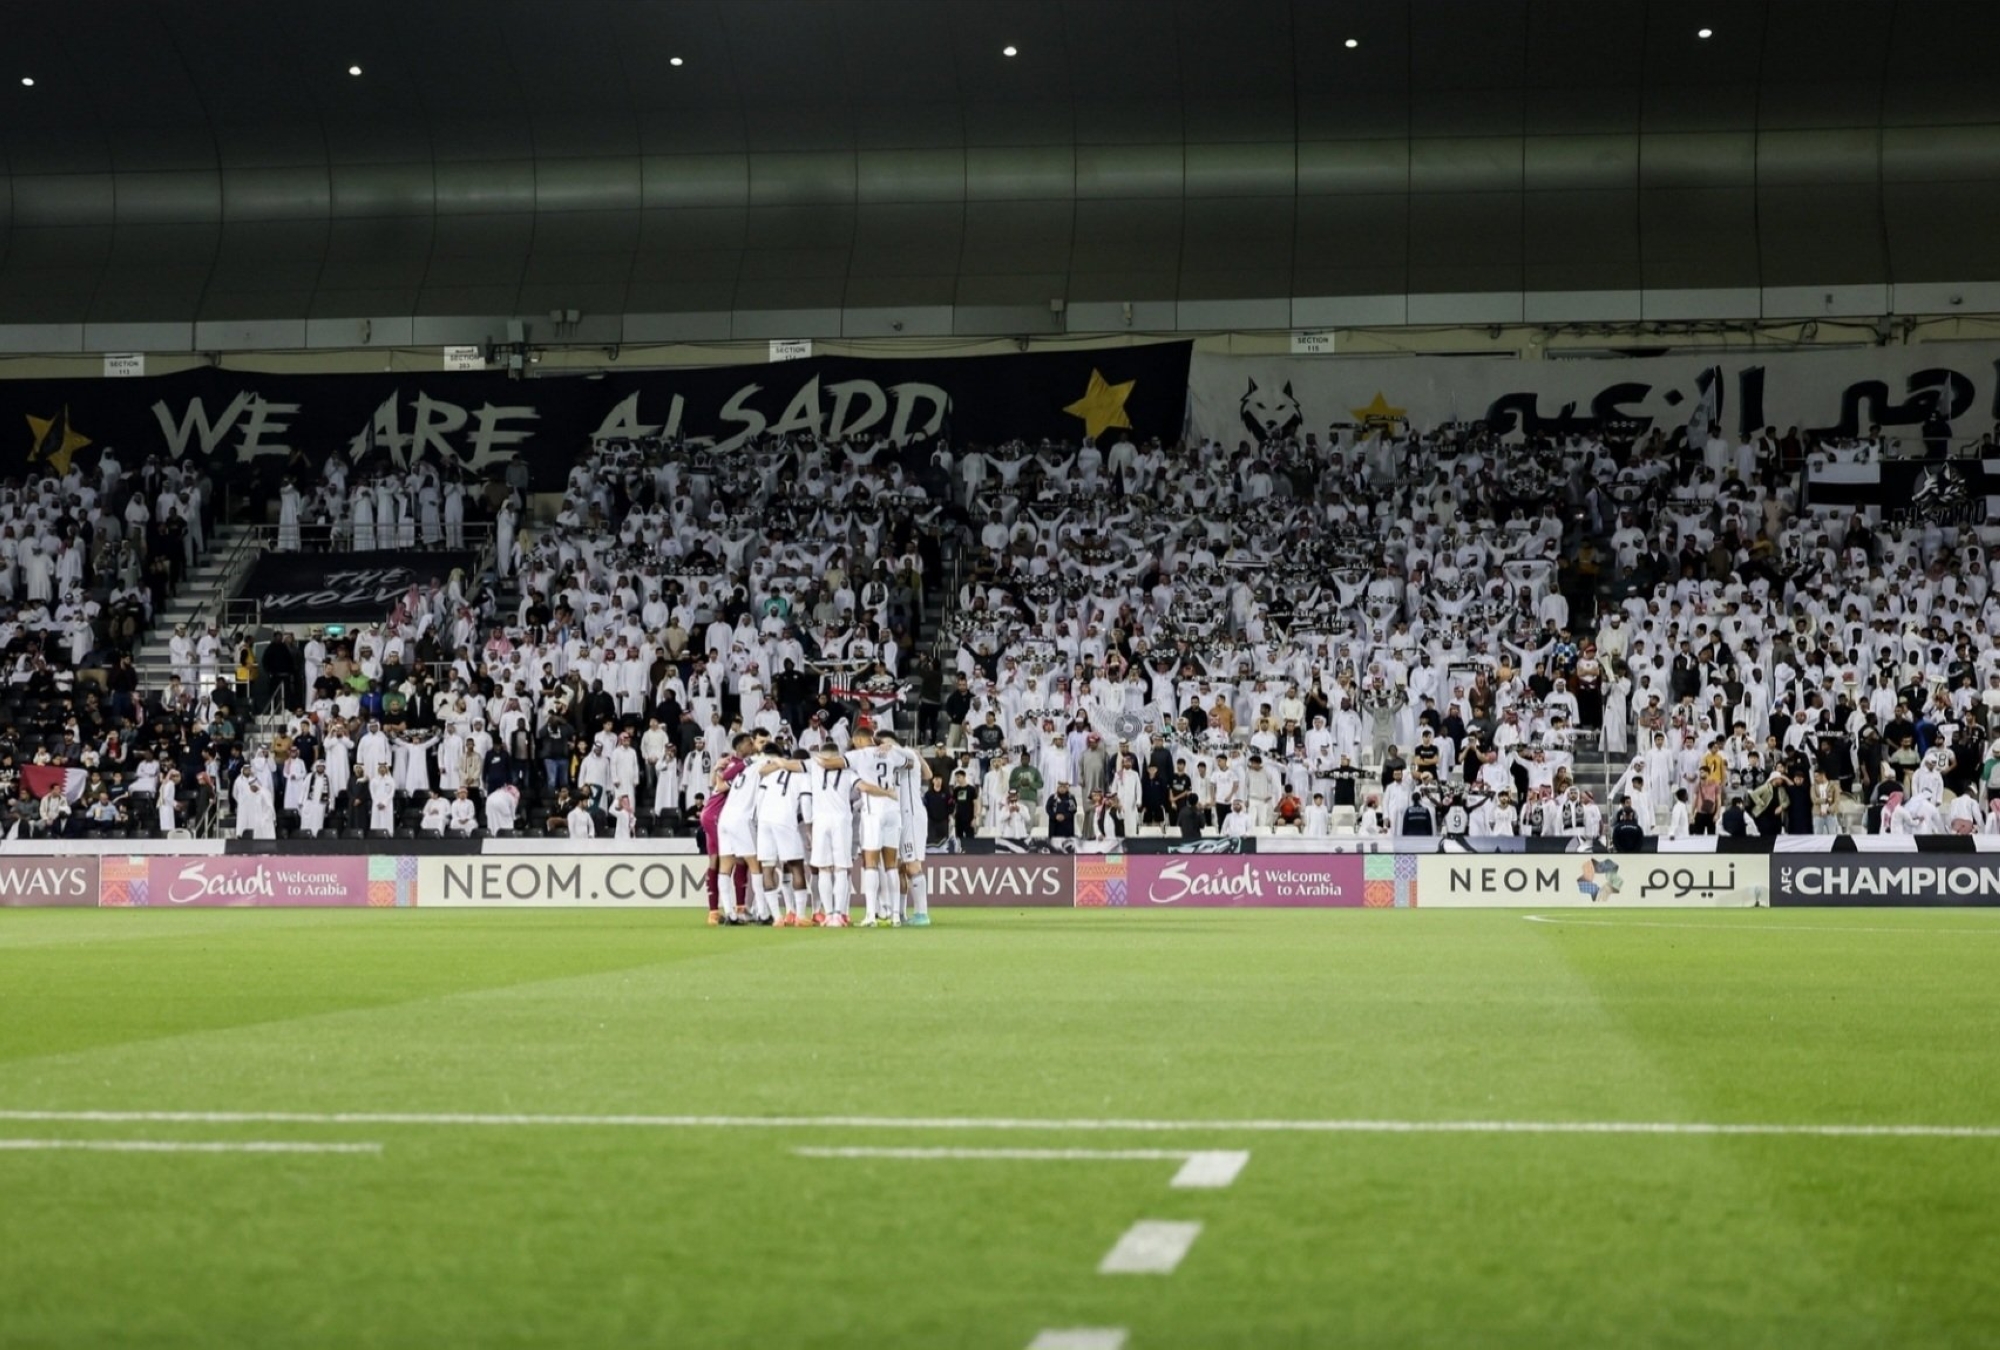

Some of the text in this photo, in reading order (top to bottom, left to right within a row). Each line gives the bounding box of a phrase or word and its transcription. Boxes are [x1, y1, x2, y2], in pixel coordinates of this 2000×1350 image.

[109, 360, 139, 368] SECTION
[151, 372, 951, 475] WE ARE AL SADD
[325, 567, 413, 588] THE
[263, 586, 426, 609] WOLV
[776, 770, 792, 796] 4
[1454, 815, 1462, 828] 9
[277, 871, 338, 883] Welcome
[443, 863, 709, 899] NEOM.COM
[927, 866, 1061, 895] IRWAYS
[1265, 869, 1331, 883] Welcome
[1450, 867, 1560, 892] NEOM
[1640, 862, 1736, 898] نيوم
[1781, 866, 1793, 894] AFC
[1794, 866, 2000, 895] CHAMPION
[287, 883, 347, 896] to Arabia
[1277, 883, 1342, 896] to Arabia
